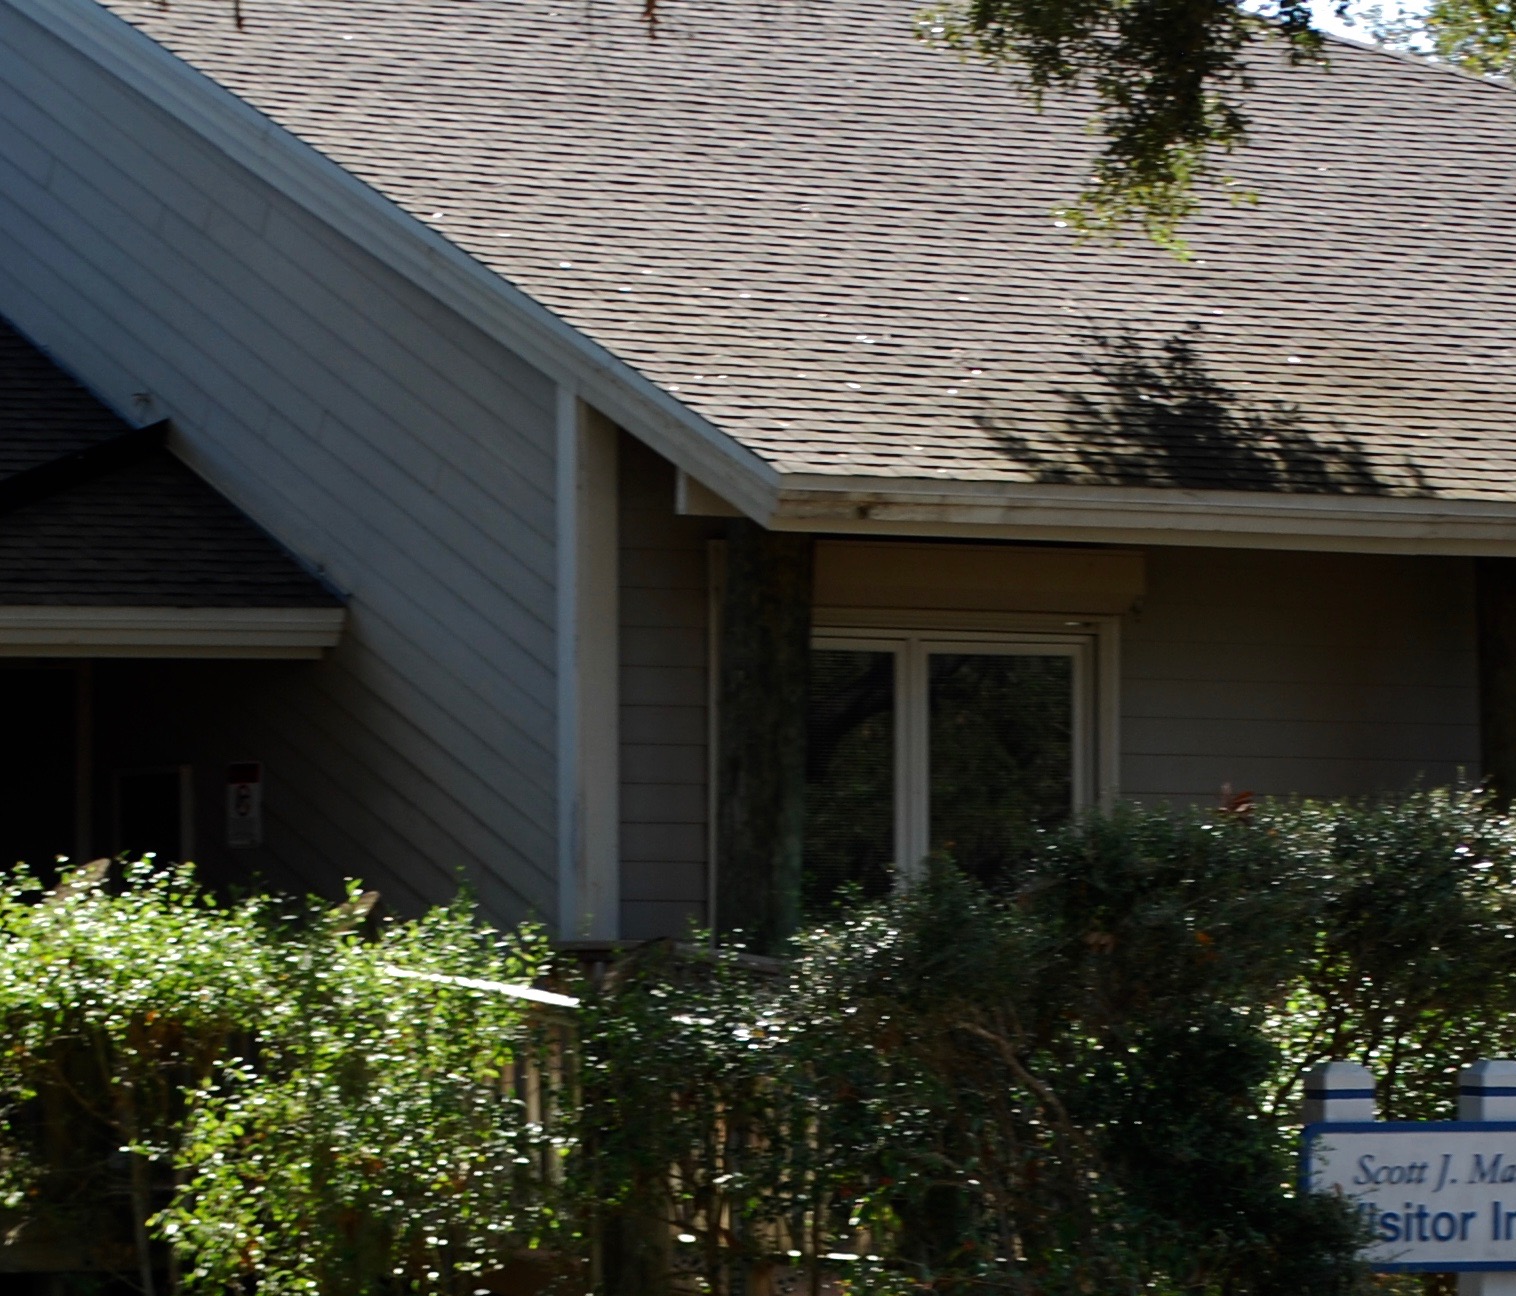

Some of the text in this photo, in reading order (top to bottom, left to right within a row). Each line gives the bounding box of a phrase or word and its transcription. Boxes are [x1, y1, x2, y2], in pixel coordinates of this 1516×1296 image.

[1353, 1154, 1428, 1185] Scott
[1431, 1153, 1458, 1193] J.
[1357, 1201, 1477, 1242] isitor
